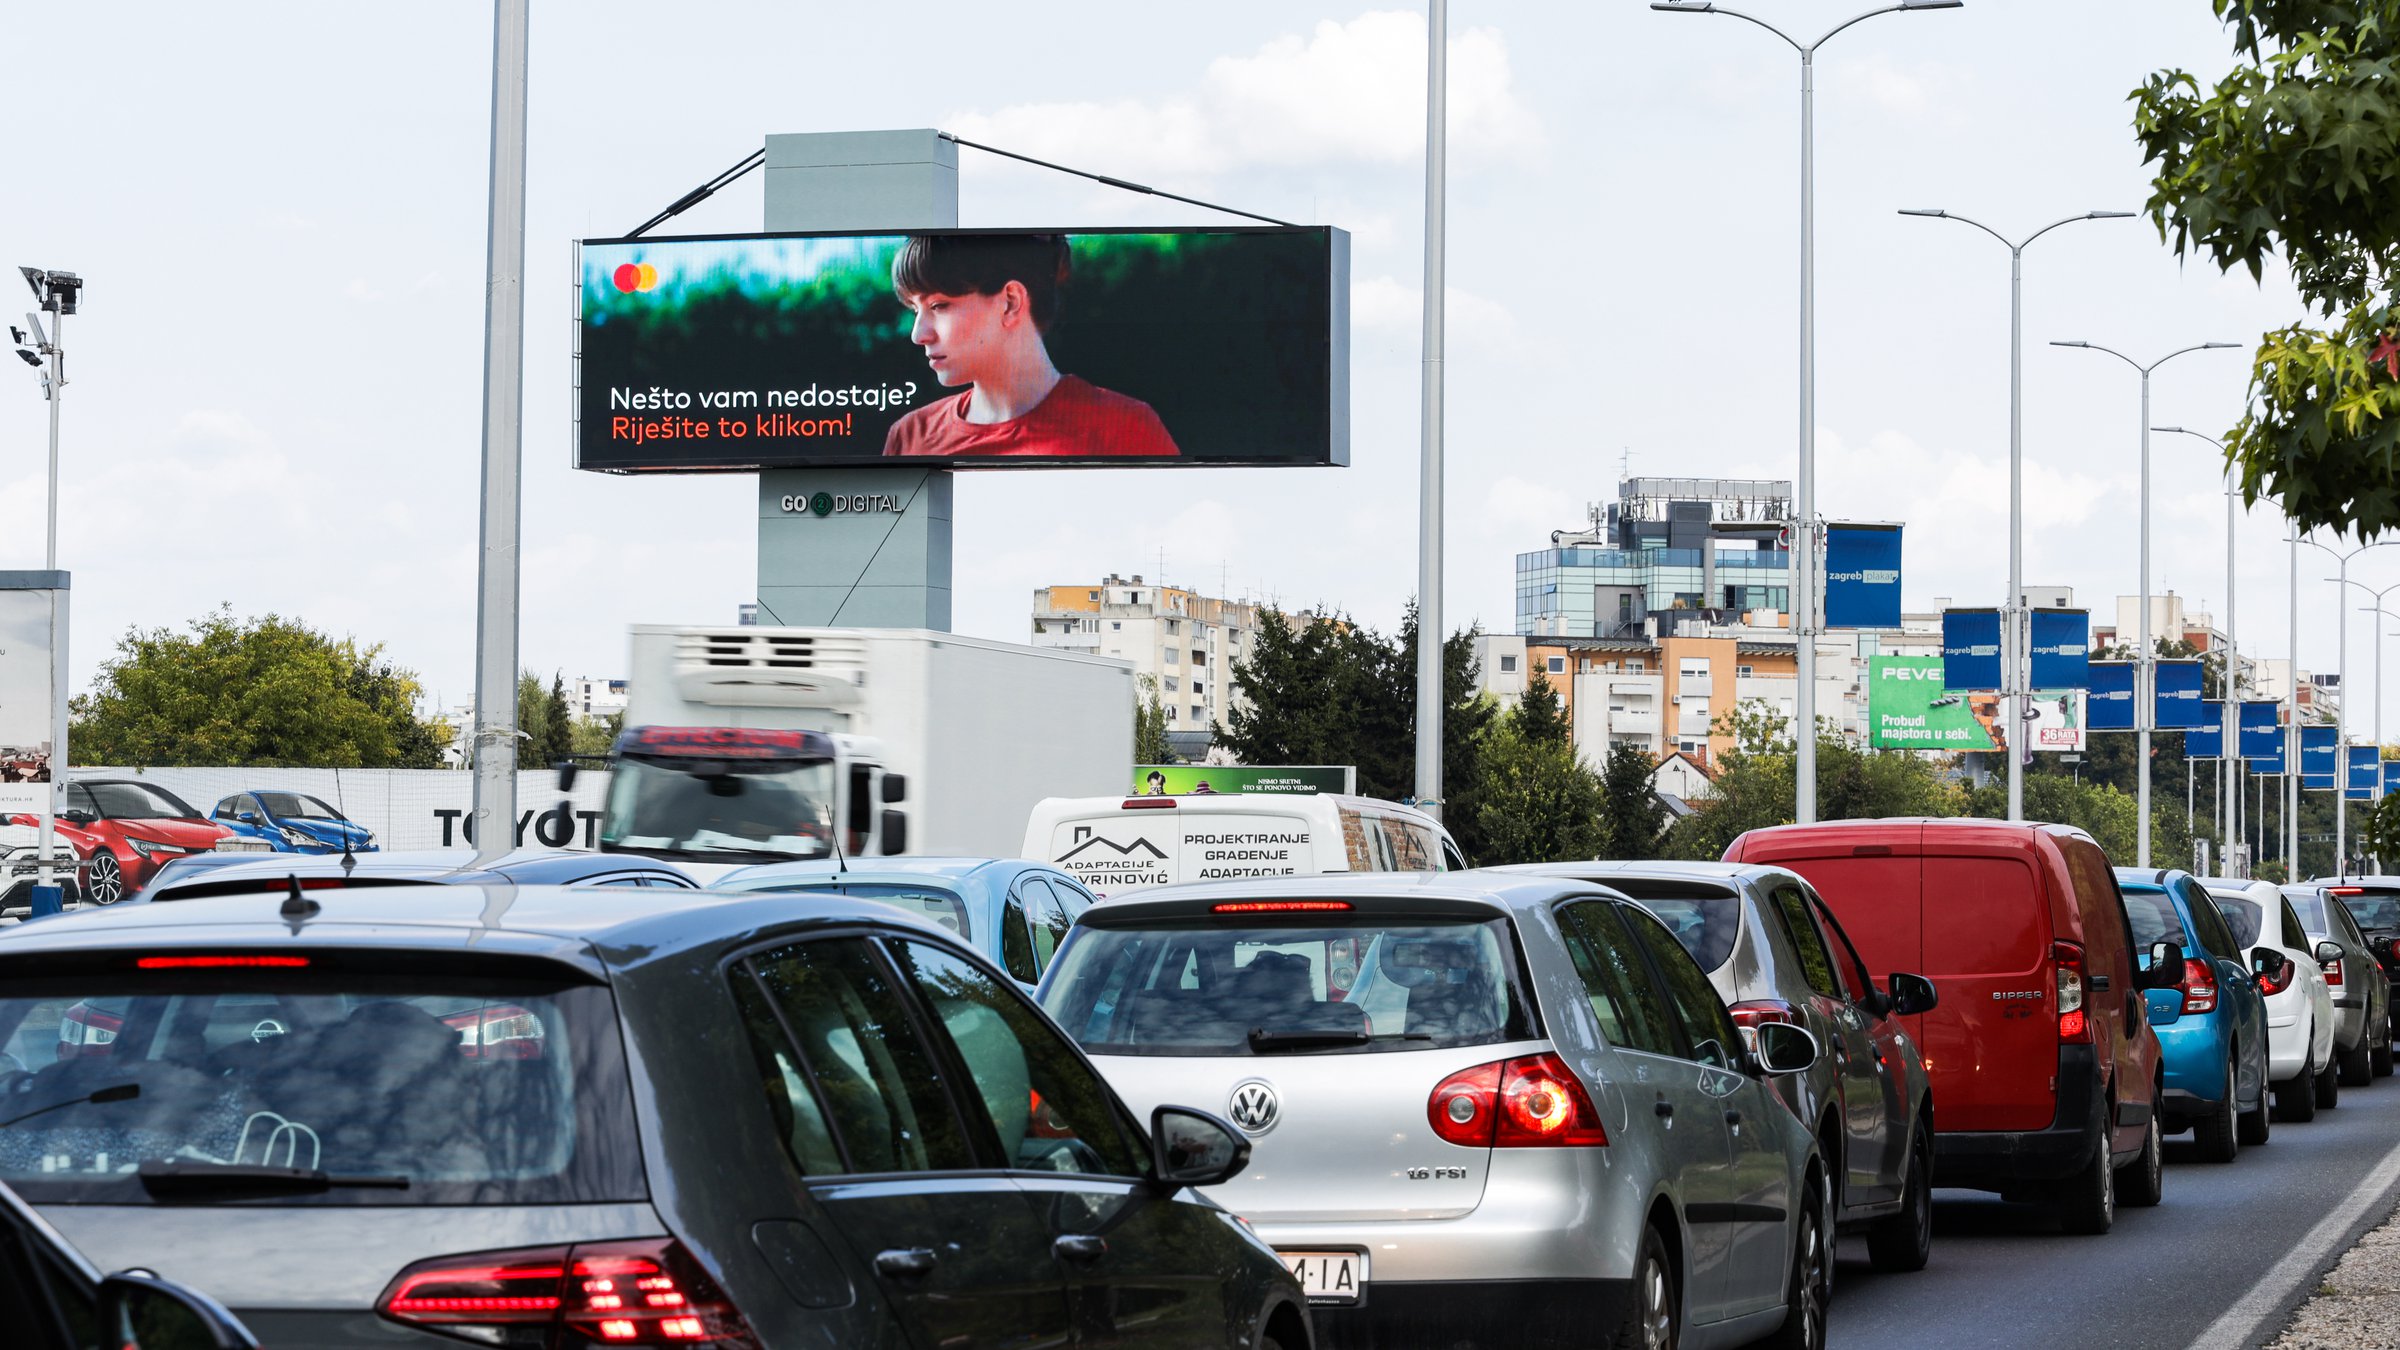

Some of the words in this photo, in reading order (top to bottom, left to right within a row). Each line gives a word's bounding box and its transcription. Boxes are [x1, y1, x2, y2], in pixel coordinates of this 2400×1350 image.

[610, 386, 691, 410] Nešto
[699, 391, 758, 409] vam
[767, 381, 917, 412] nedostaje?
[612, 416, 710, 445] Riješite
[718, 417, 747, 438] to
[756, 412, 853, 437] klikom!
[781, 495, 807, 512] GO
[835, 495, 903, 512] DIGITAL
[1829, 571, 1862, 582] zagreb
[1945, 647, 1971, 656] zagreb
[2033, 646, 2059, 654] zagreb
[1882, 667, 1945, 681] PEVE
[1881, 714, 1926, 727] Probudi
[1881, 727, 1932, 741] majstora
[1934, 730, 1943, 739] u
[1945, 728, 1972, 740] sebi.
[2042, 729, 2058, 741] 36
[1184, 833, 1310, 845] PROJEKTIRANJE
[1205, 850, 1289, 861] GRAĐENJE
[1064, 860, 1155, 870] ADAPTACIJE
[1073, 869, 1168, 885] VRINOVIĆ
[1199, 867, 1295, 879] ADAPTACIJE
[1992, 991, 2043, 1000] BIPPER
[1435, 1166, 1467, 1180] FSI
